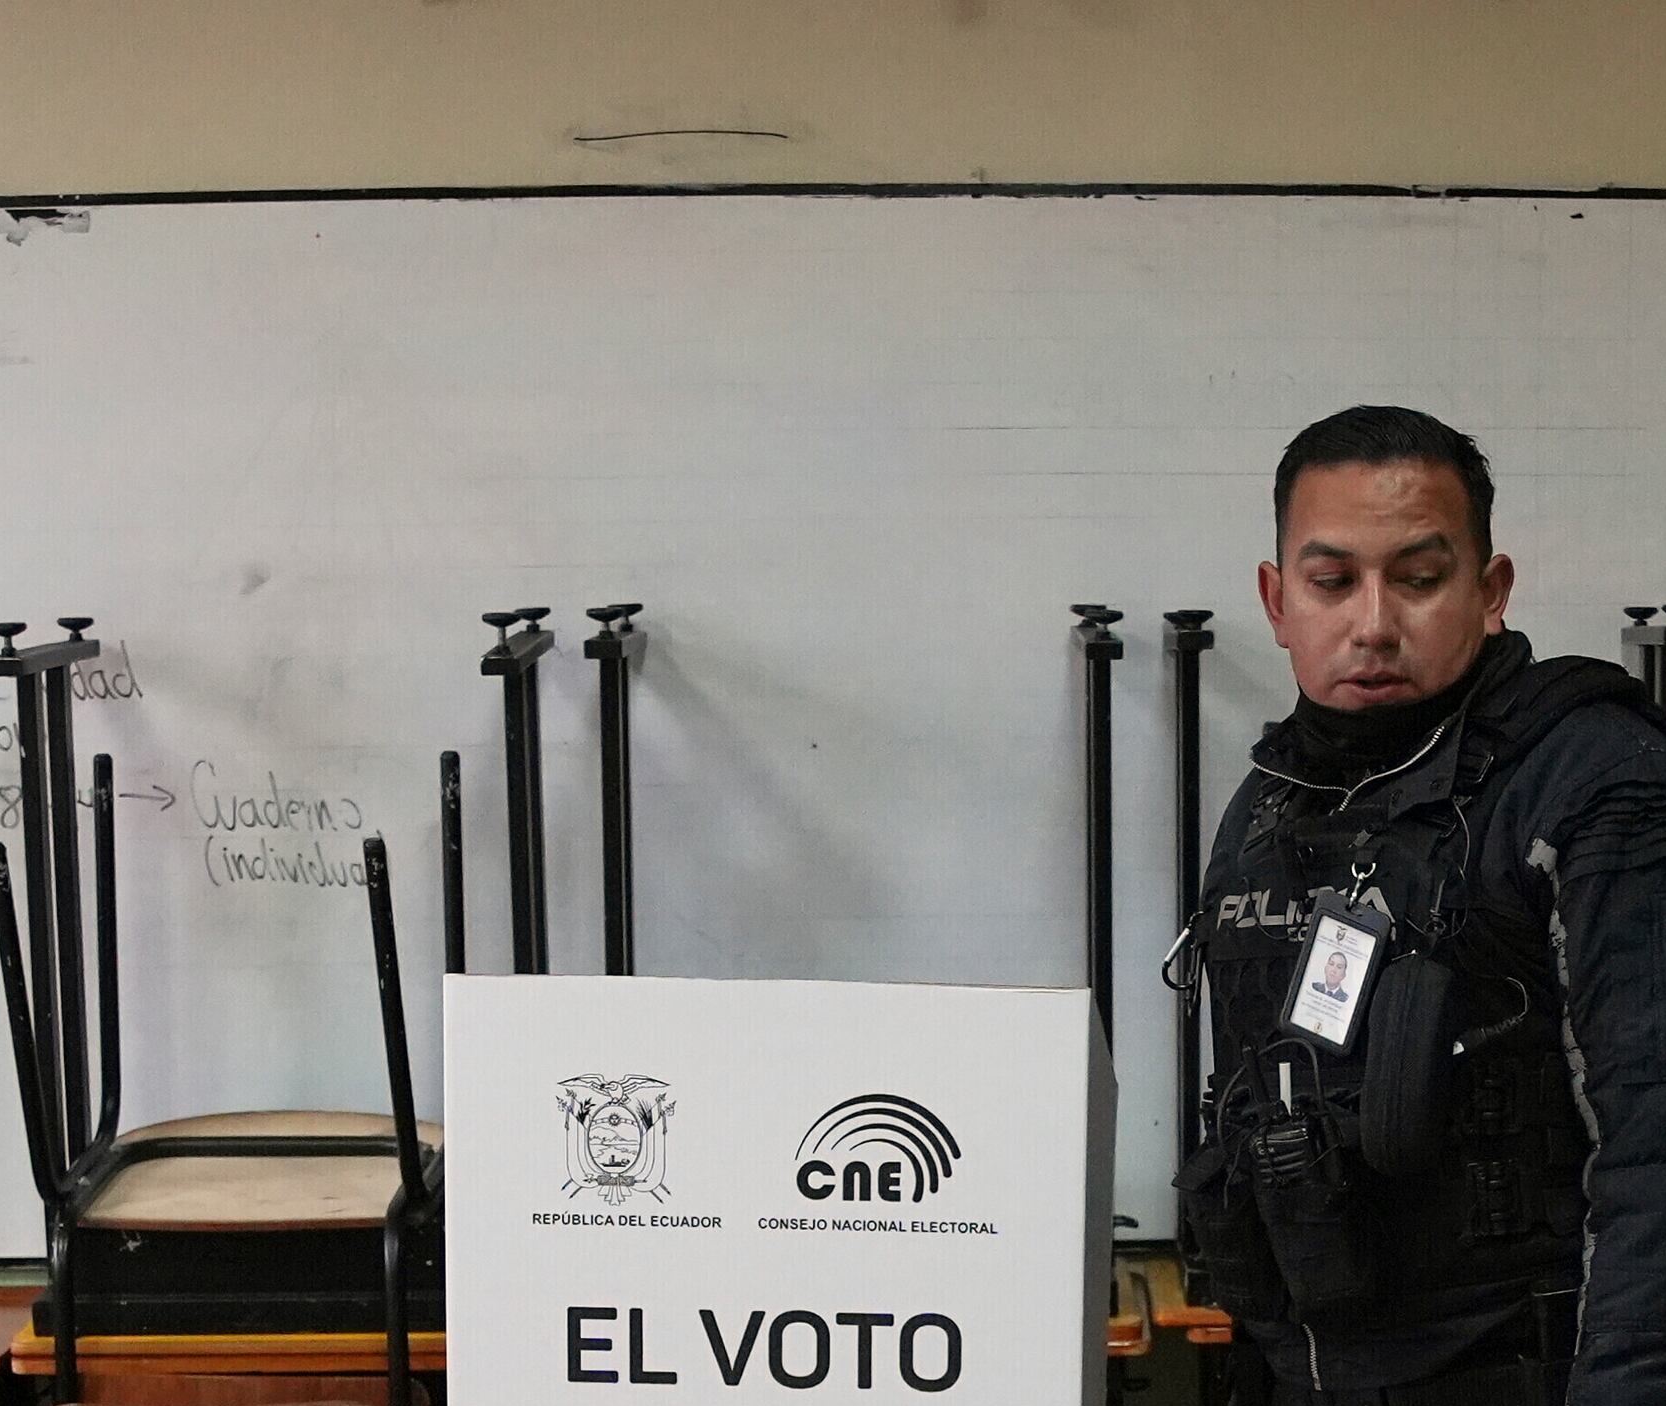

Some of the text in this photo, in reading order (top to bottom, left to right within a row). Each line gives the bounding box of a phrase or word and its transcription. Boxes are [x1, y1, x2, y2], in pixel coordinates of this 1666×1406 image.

[190, 760, 362, 831] Cuaderno
[205, 834, 370, 887] (individua
[796, 1160, 902, 1202] CNE
[532, 1210, 722, 1228] REPÚBLICA DEL ECUADOR
[758, 1217, 998, 1235] CONSEJO NACIONAL ELECTORAL
[568, 1307, 961, 1392] EL VOTO
